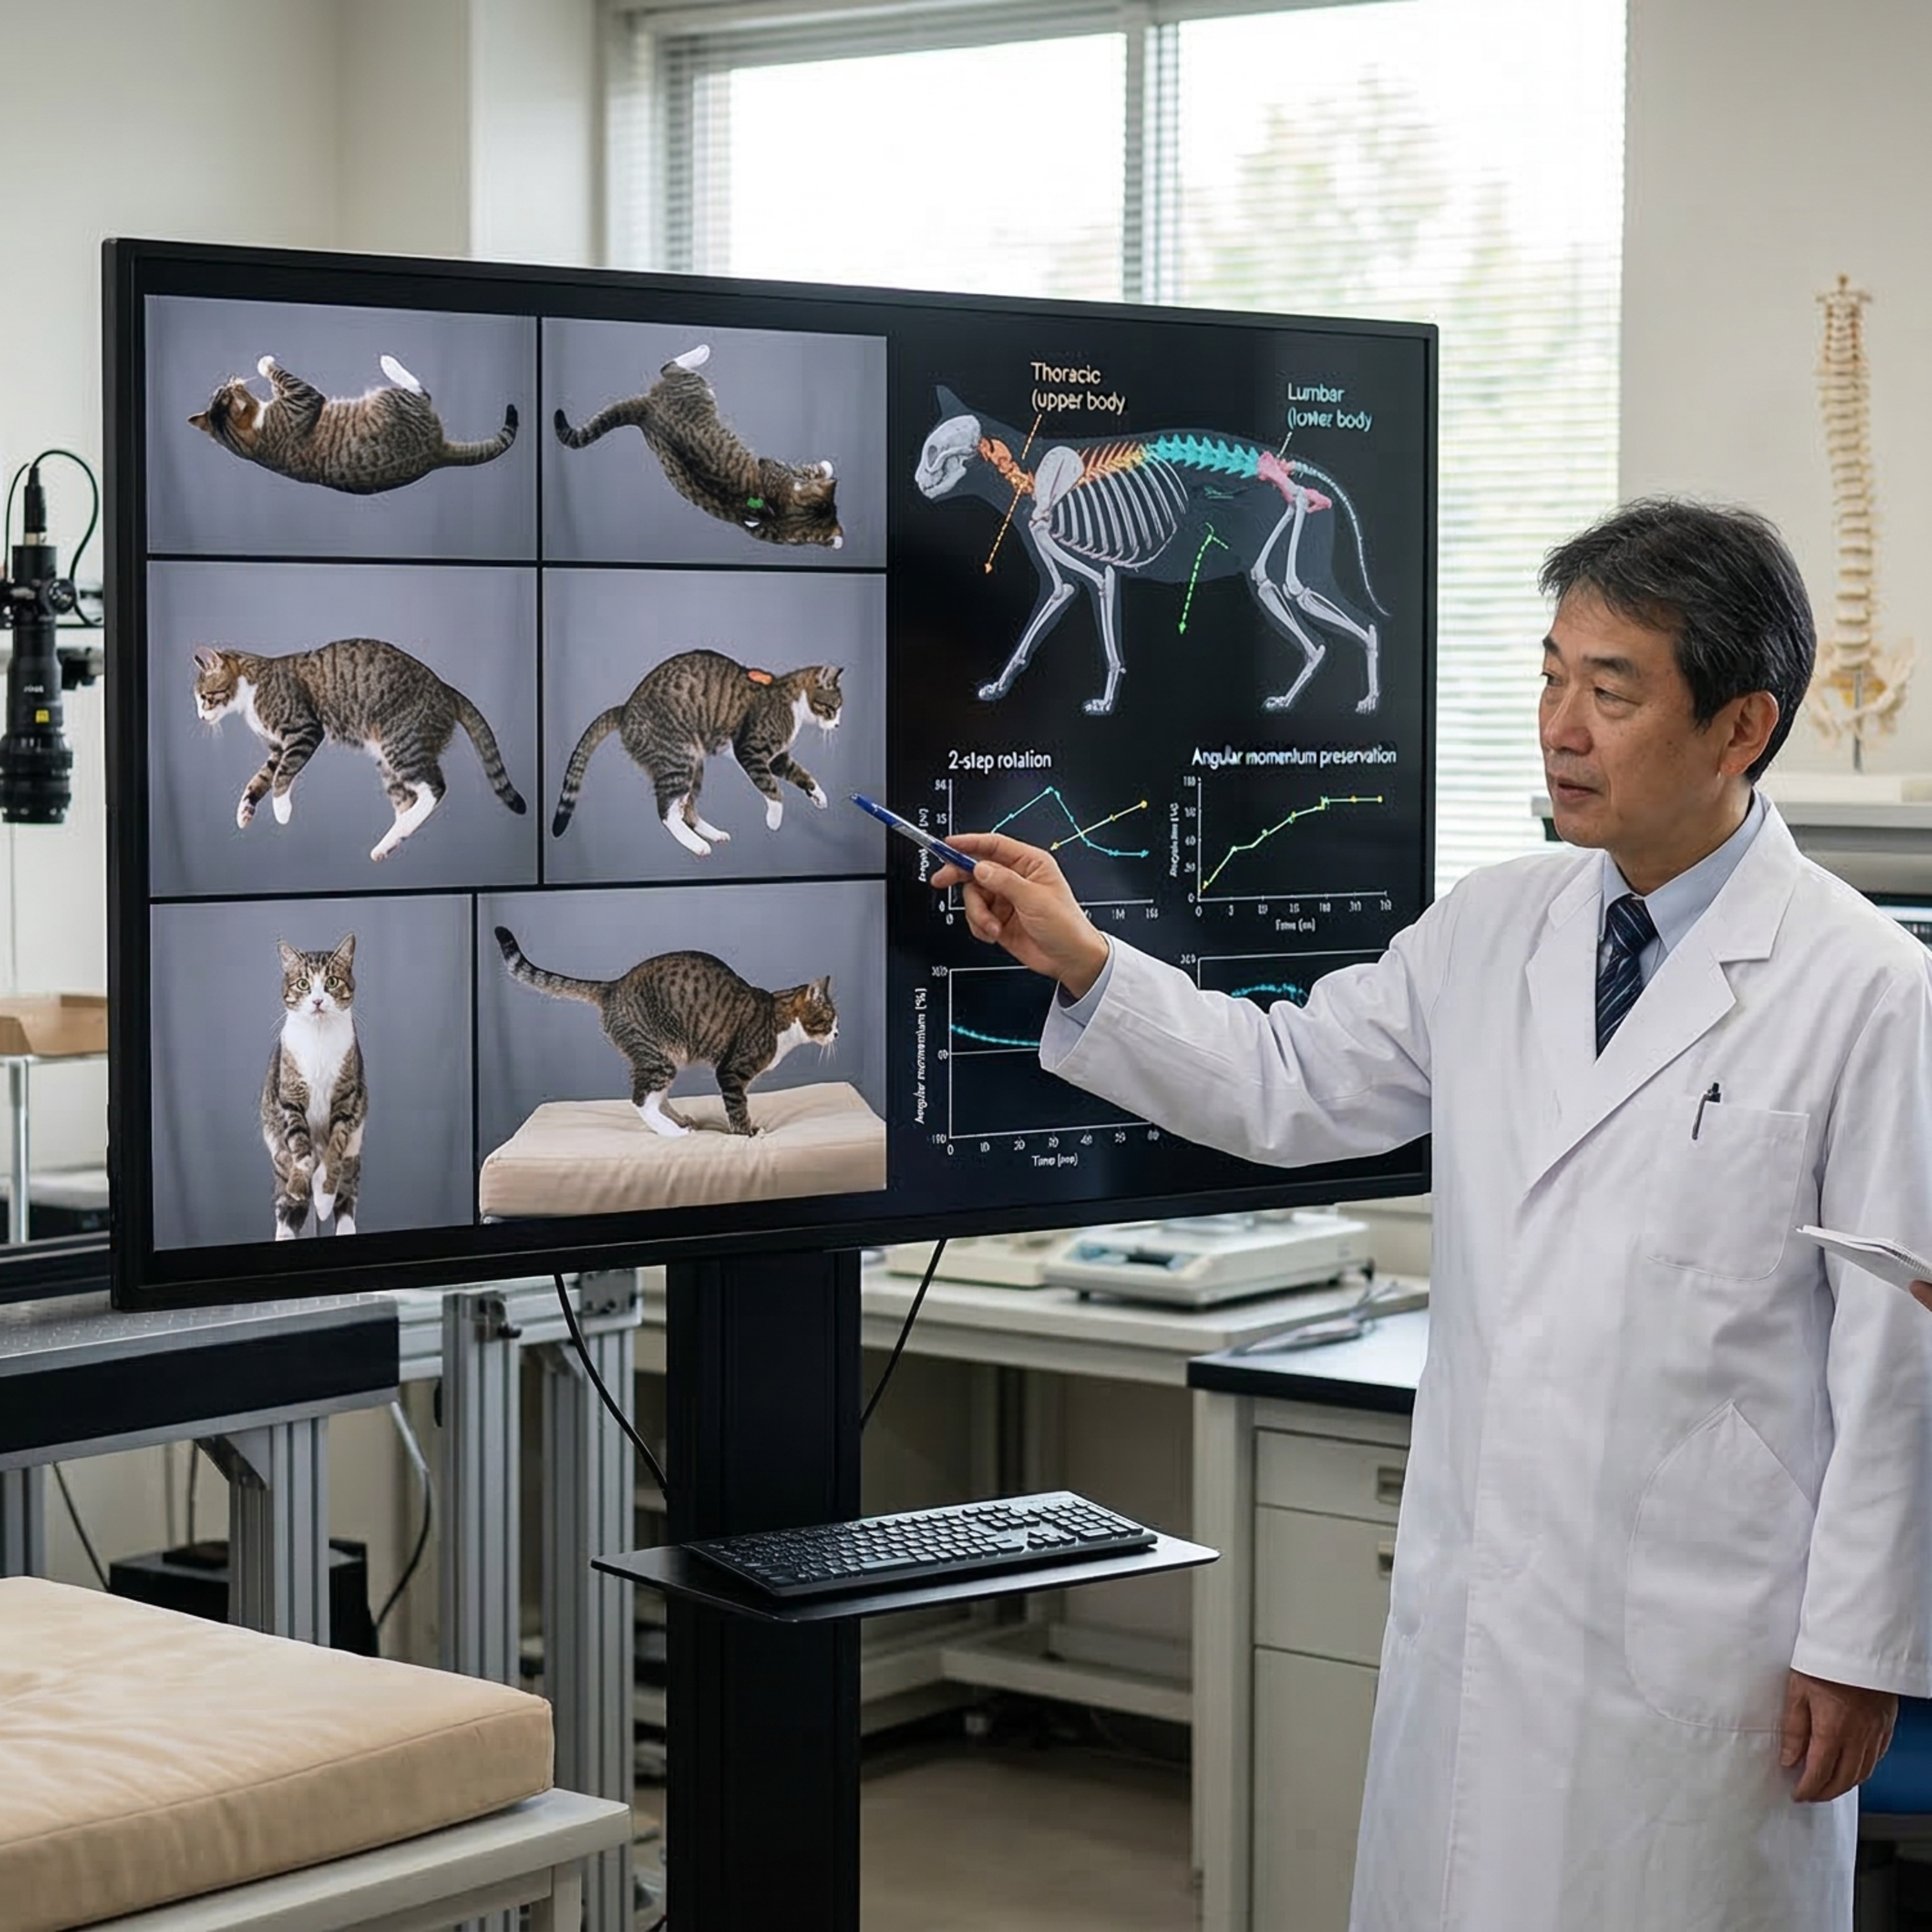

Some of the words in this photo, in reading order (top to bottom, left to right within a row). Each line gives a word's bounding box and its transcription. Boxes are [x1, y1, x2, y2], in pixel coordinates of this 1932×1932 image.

[1030, 362, 1101, 384] Thoracic
[1032, 388, 1083, 412] (upper
[1087, 390, 1126, 415] body
[1288, 383, 1345, 403] Lumbar
[1336, 409, 1372, 432] body
[1191, 744, 1244, 770] Angular
[1245, 747, 1317, 765] momentum
[1320, 744, 1397, 768] preservation
